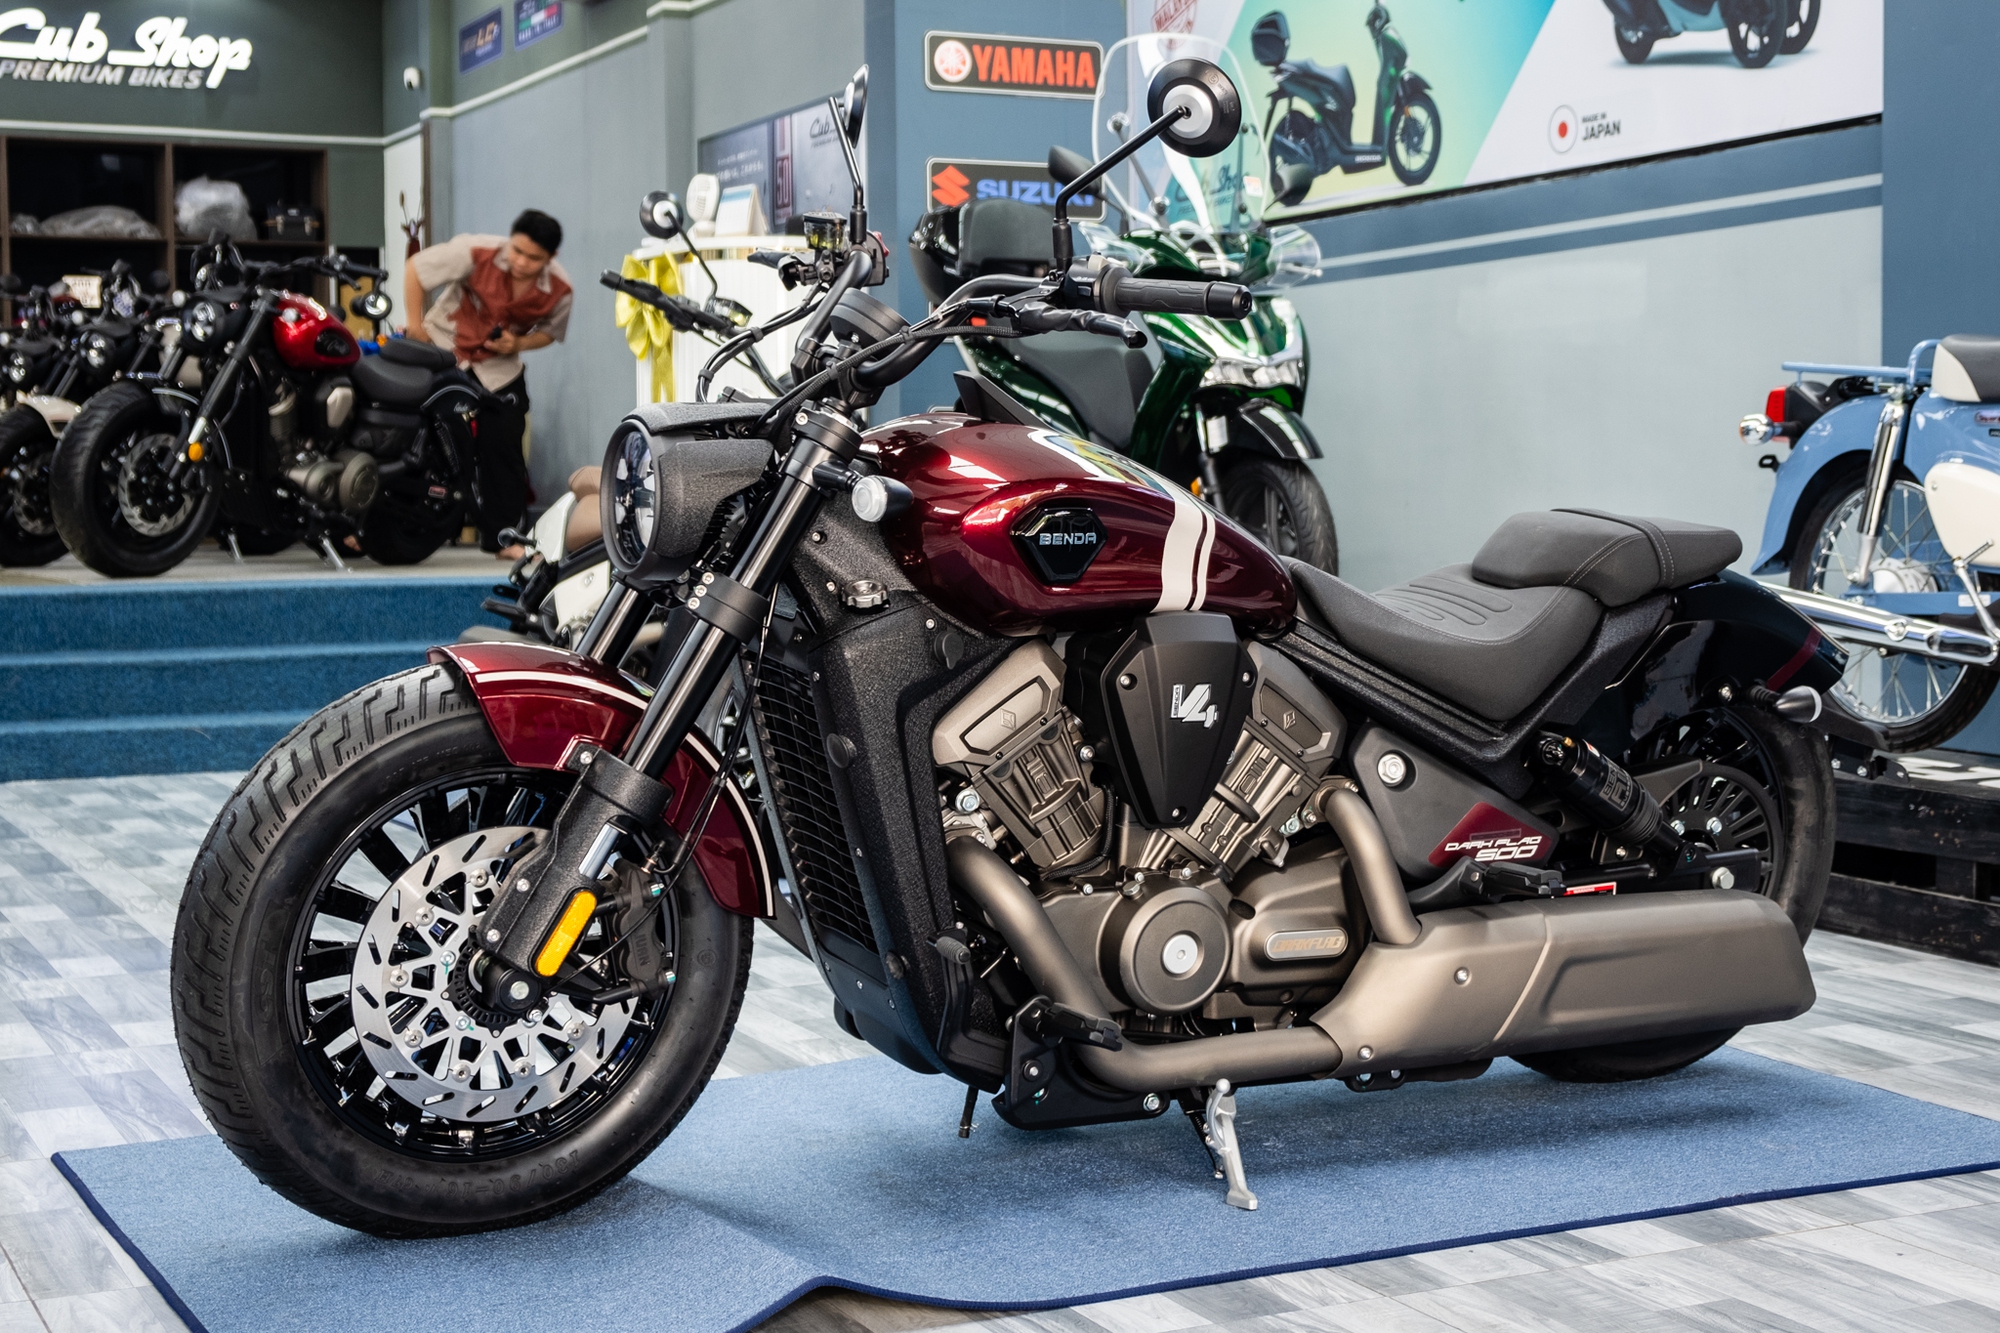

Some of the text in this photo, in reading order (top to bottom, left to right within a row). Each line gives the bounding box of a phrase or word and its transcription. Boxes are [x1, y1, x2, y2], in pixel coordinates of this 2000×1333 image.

[0, 7, 253, 89] Cub Shop
[0, 60, 204, 89] PREMIUM BIKES
[972, 44, 1096, 88] YAMAHA
[809, 114, 830, 139] Cub
[1582, 122, 1621, 142] JAPAN
[976, 179, 1094, 207] SUZUI
[1039, 532, 1097, 546] BENDA
[1170, 683, 1219, 729] V4
[1444, 836, 1542, 851] DARK FLAG
[1474, 845, 1539, 862] 500
